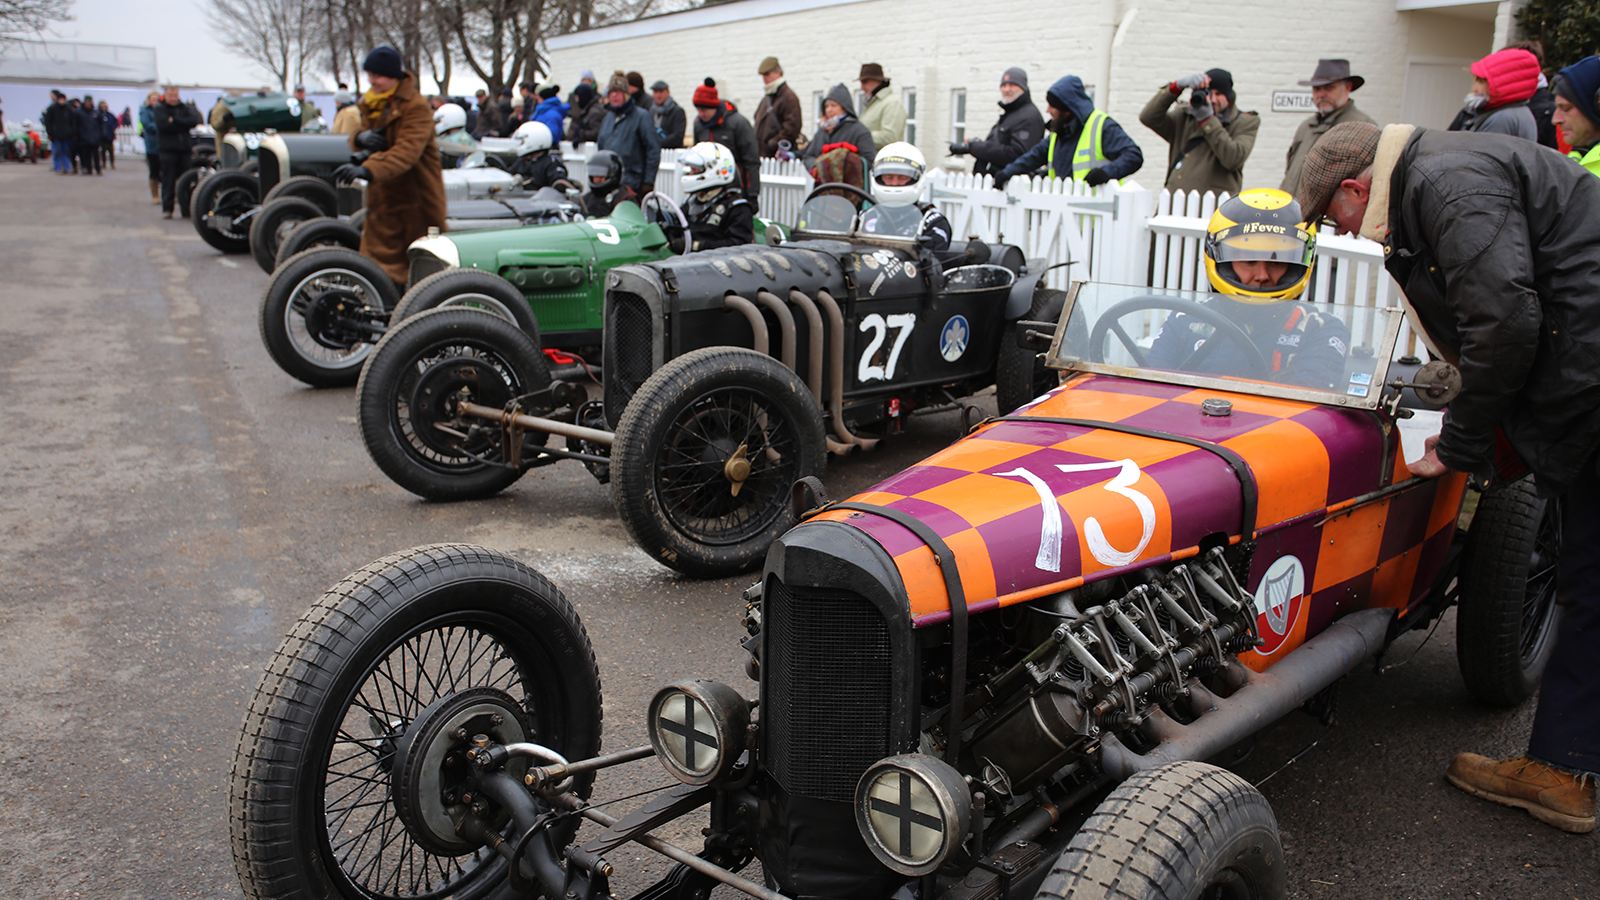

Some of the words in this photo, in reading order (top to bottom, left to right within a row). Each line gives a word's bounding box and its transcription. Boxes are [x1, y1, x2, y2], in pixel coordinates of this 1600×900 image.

[586, 219, 620, 245] 5
[1243, 222, 1286, 234] #Fever
[858, 313, 916, 382] 27
